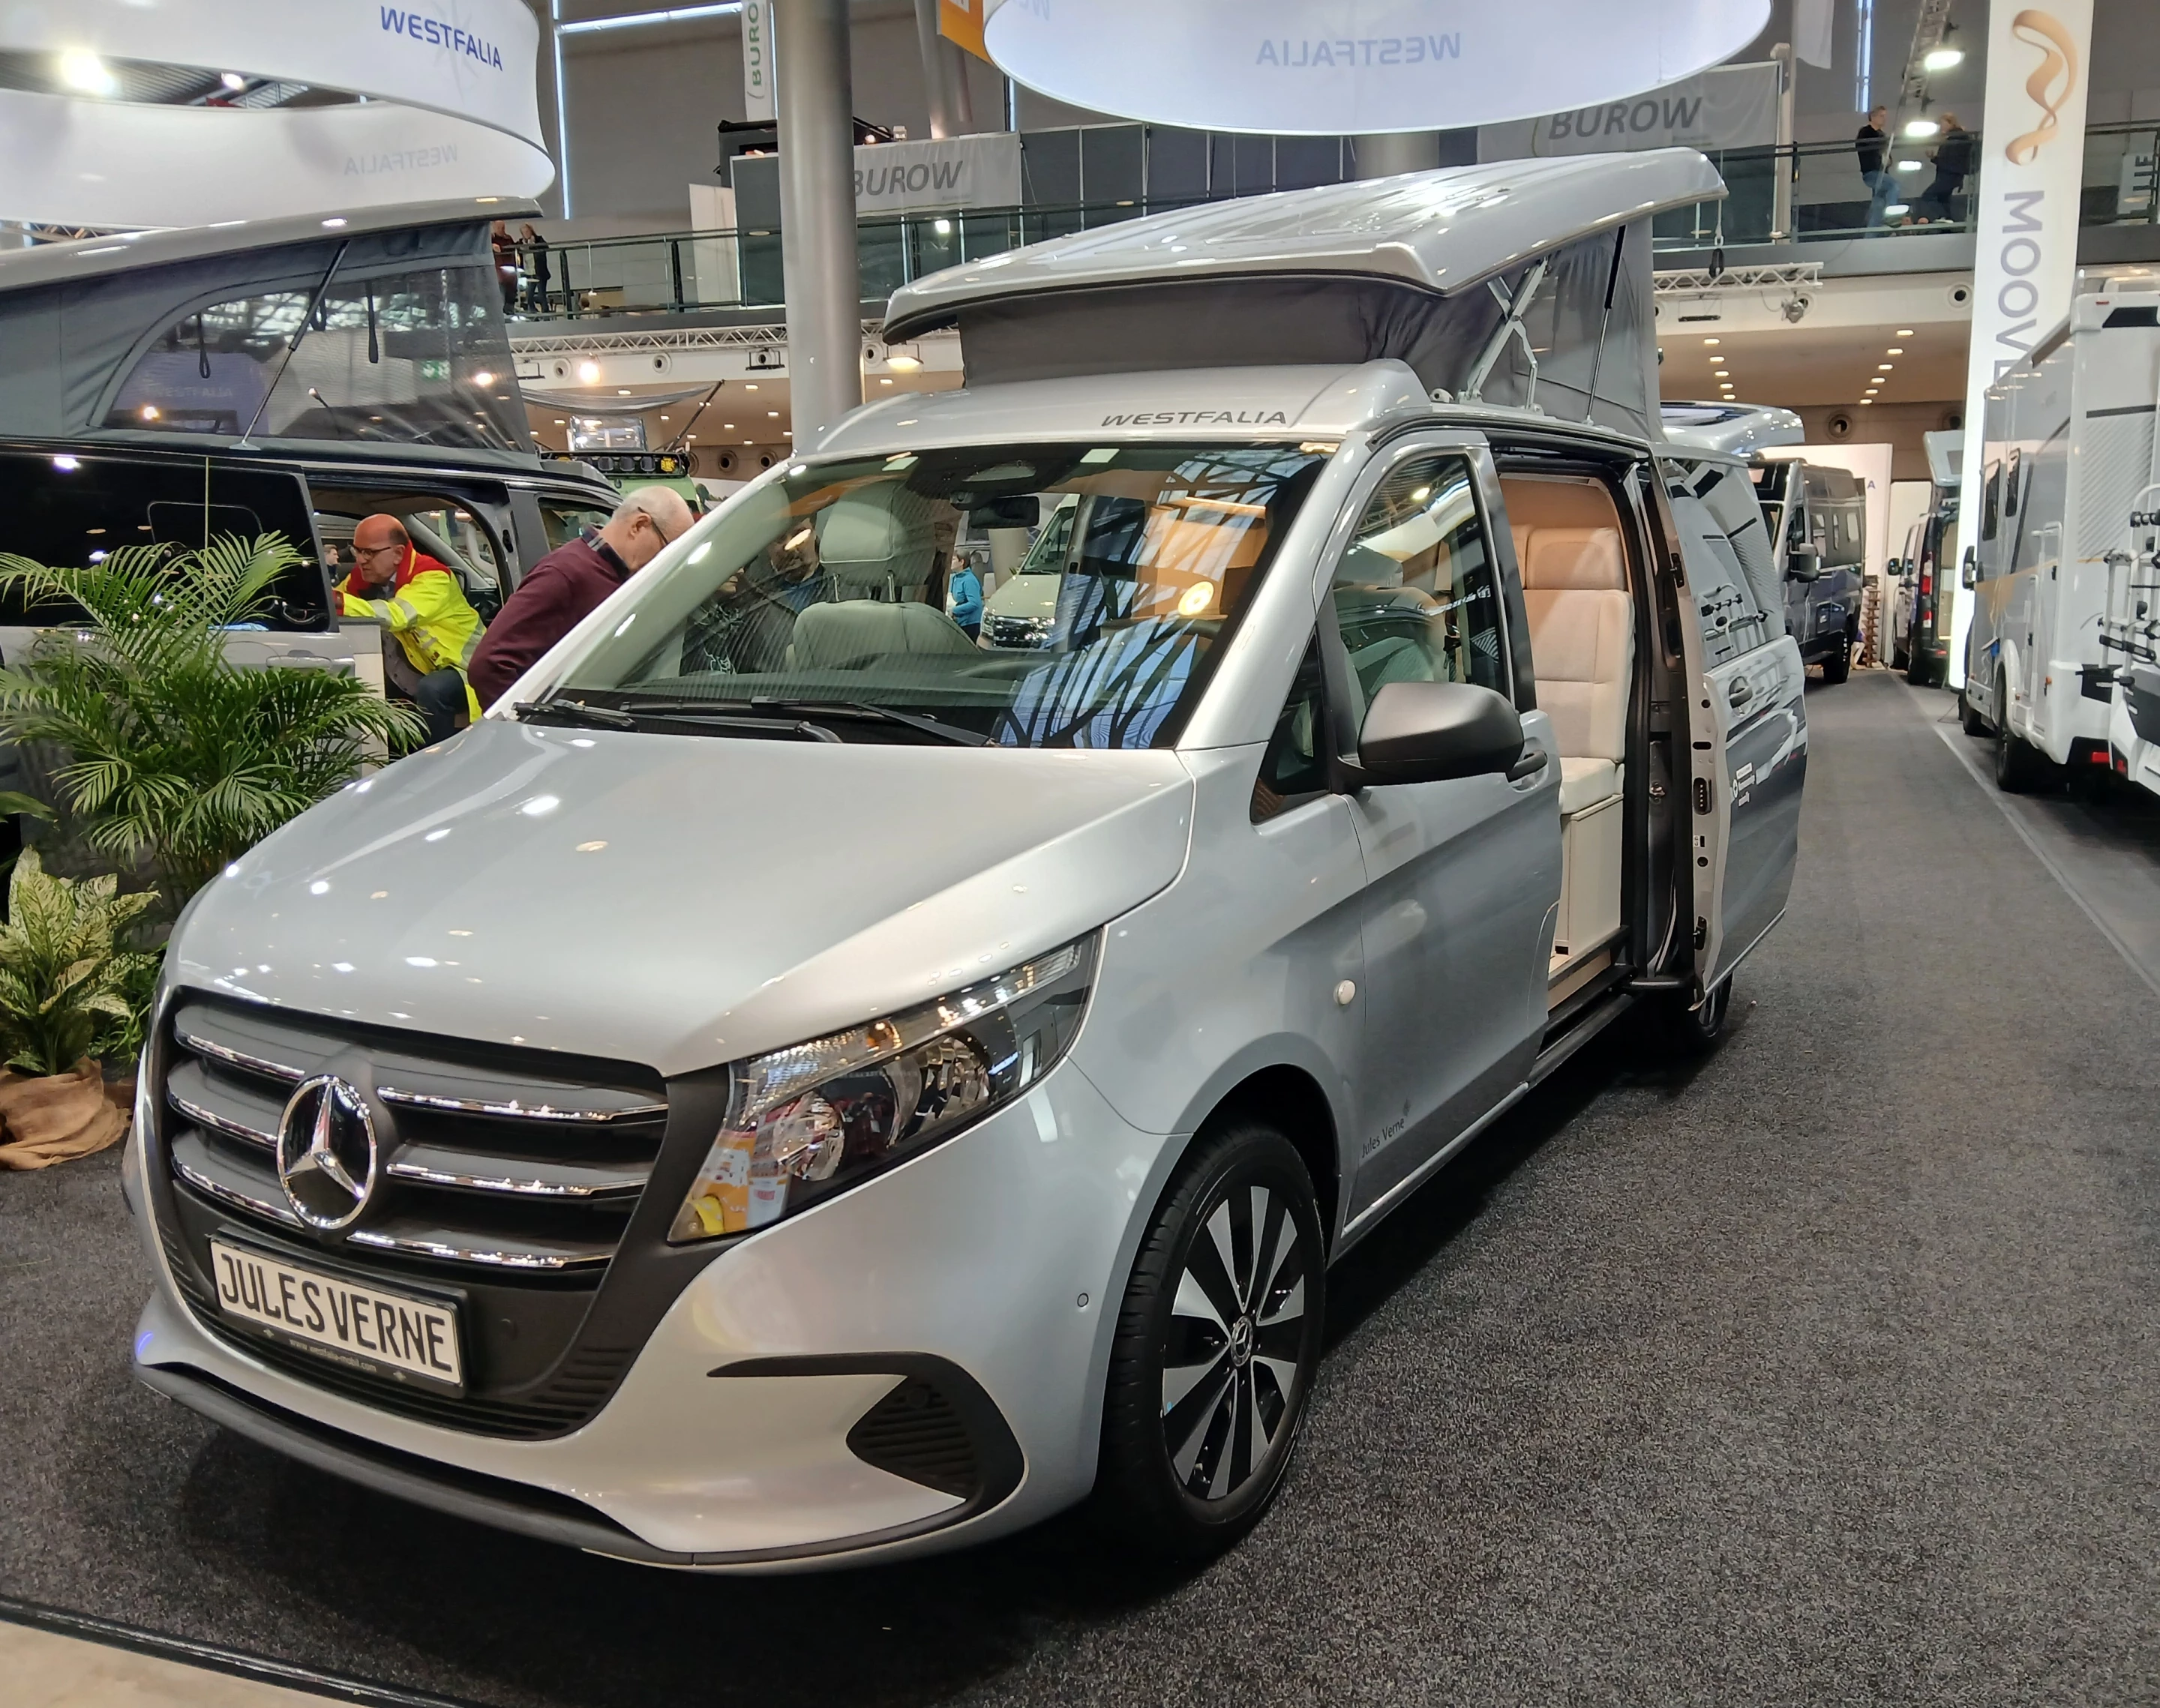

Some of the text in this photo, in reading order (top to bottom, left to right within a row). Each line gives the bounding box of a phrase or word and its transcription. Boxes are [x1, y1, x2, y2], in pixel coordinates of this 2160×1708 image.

[380, 5, 503, 72] WESTFALIA
[1548, 97, 1703, 140] BUROW
[1101, 411, 1287, 427] WESTFALIA
[1361, 1118, 1405, 1158] Jules Verne
